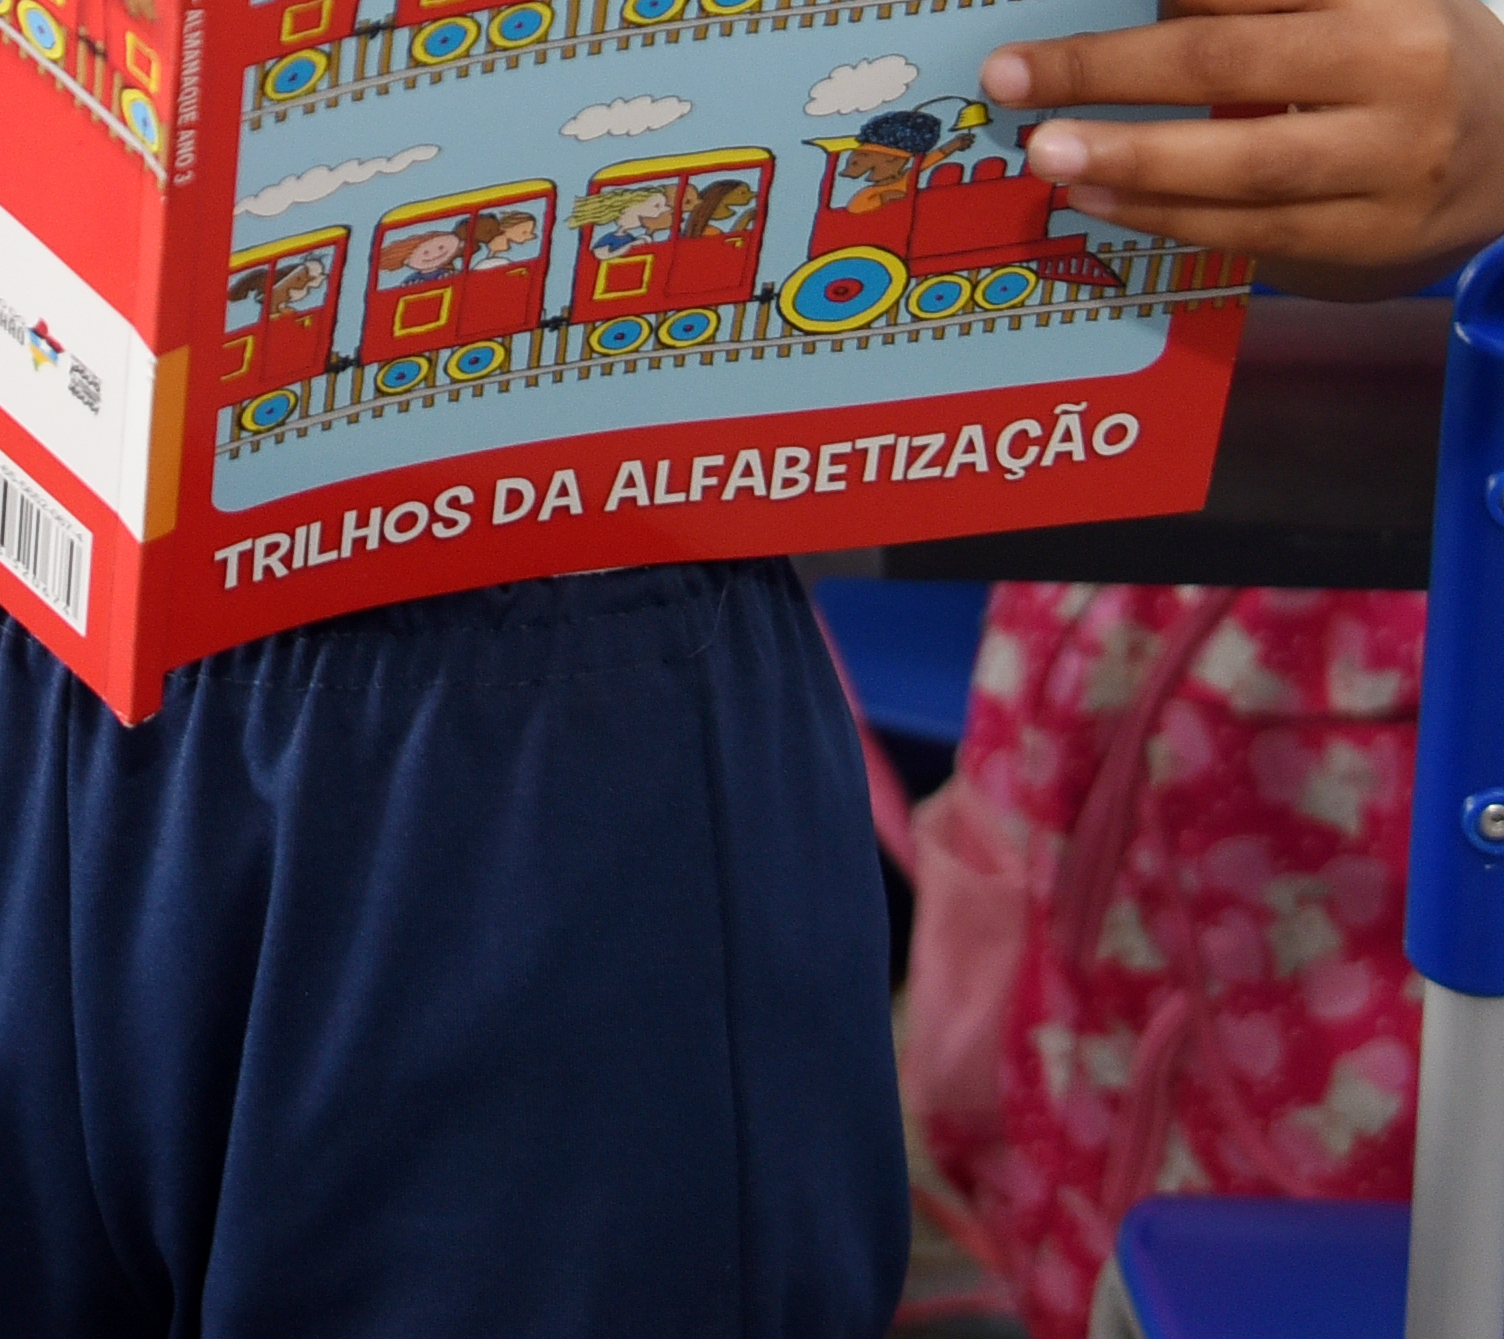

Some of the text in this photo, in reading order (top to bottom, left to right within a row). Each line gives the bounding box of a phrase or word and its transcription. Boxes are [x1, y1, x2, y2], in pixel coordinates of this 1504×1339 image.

[177, 9, 205, 127] ALMANAQUE
[173, 170, 193, 186] 3
[174, 129, 196, 170] ANO
[213, 402, 1141, 590] TRILHOS DA ALFABETIZAÇÃO
